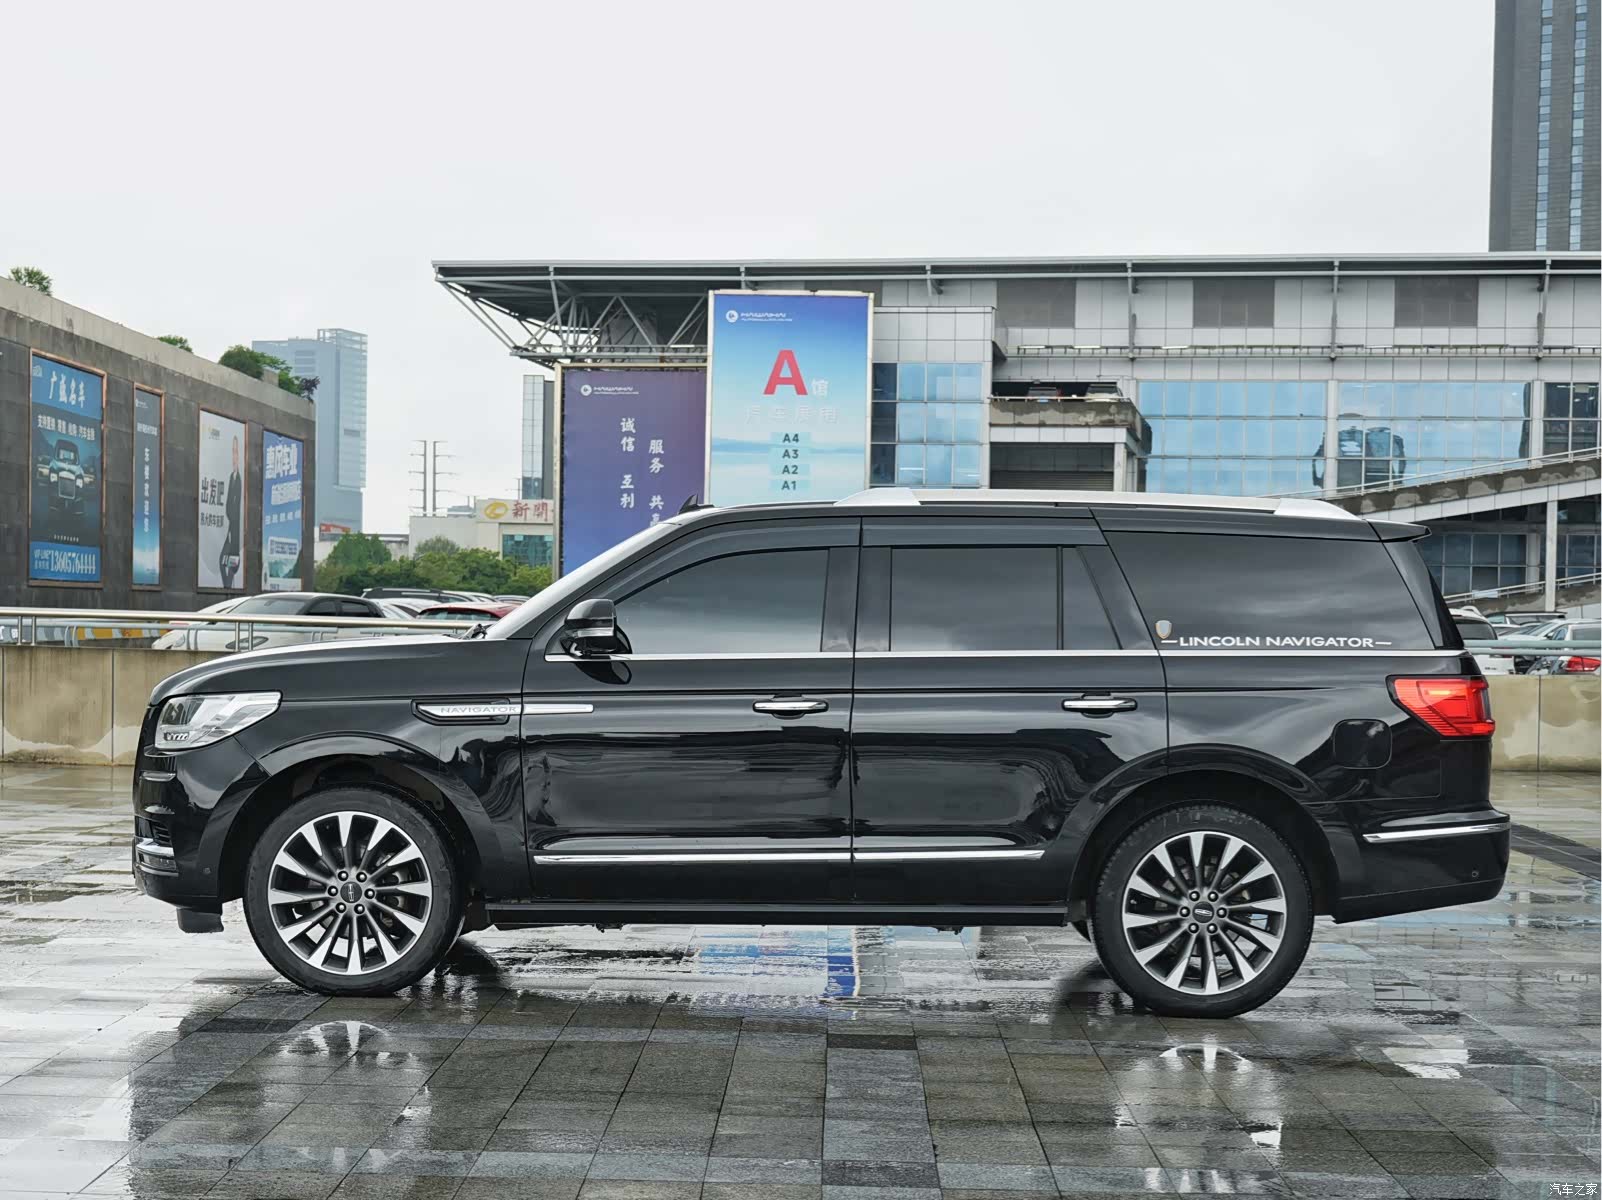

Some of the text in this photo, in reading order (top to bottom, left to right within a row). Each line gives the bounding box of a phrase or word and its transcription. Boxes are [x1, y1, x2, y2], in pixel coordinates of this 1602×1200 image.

[782, 433, 800, 443] A4
[649, 439, 664, 473] 服务
[782, 449, 799, 459] A3
[620, 417, 636, 509] 诚信 互利
[781, 465, 798, 475] A2
[781, 480, 797, 490] A1
[200, 477, 225, 506] 出发吧
[1179, 636, 1374, 648] LINCOLN NAVIGATOR
[440, 706, 517, 714] NAVIGATOR
